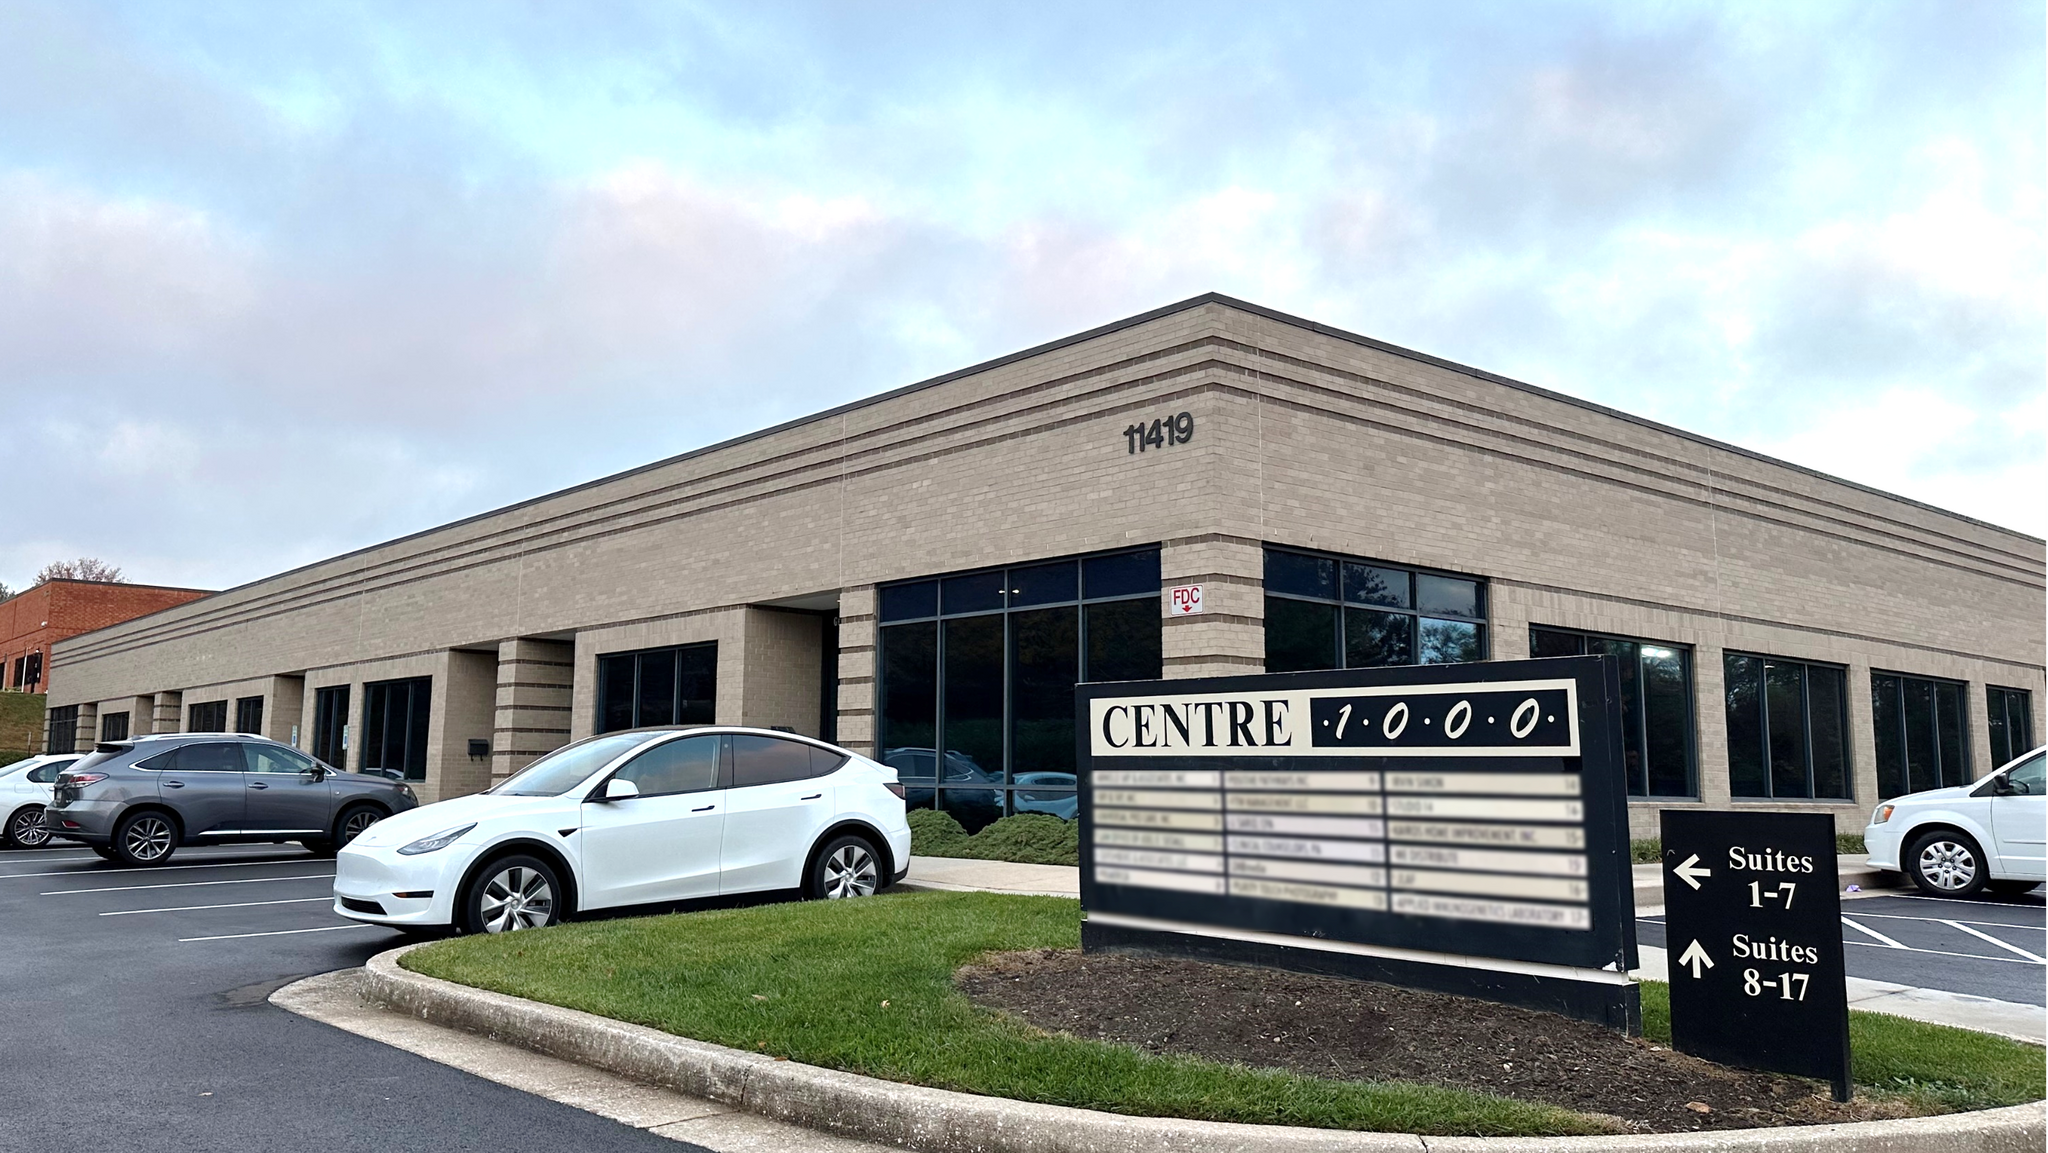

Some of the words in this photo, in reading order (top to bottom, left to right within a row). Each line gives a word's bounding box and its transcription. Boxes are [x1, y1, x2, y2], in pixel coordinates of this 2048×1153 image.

[1123, 412, 1194, 455] 11419
[1173, 587, 1200, 606] FDC
[1102, 699, 1292, 749] CENTRE
[1729, 846, 1814, 874] Suites
[1748, 880, 1797, 910] 1-7
[1732, 934, 1818, 965] Suites
[1743, 968, 1810, 1002] 8-17
